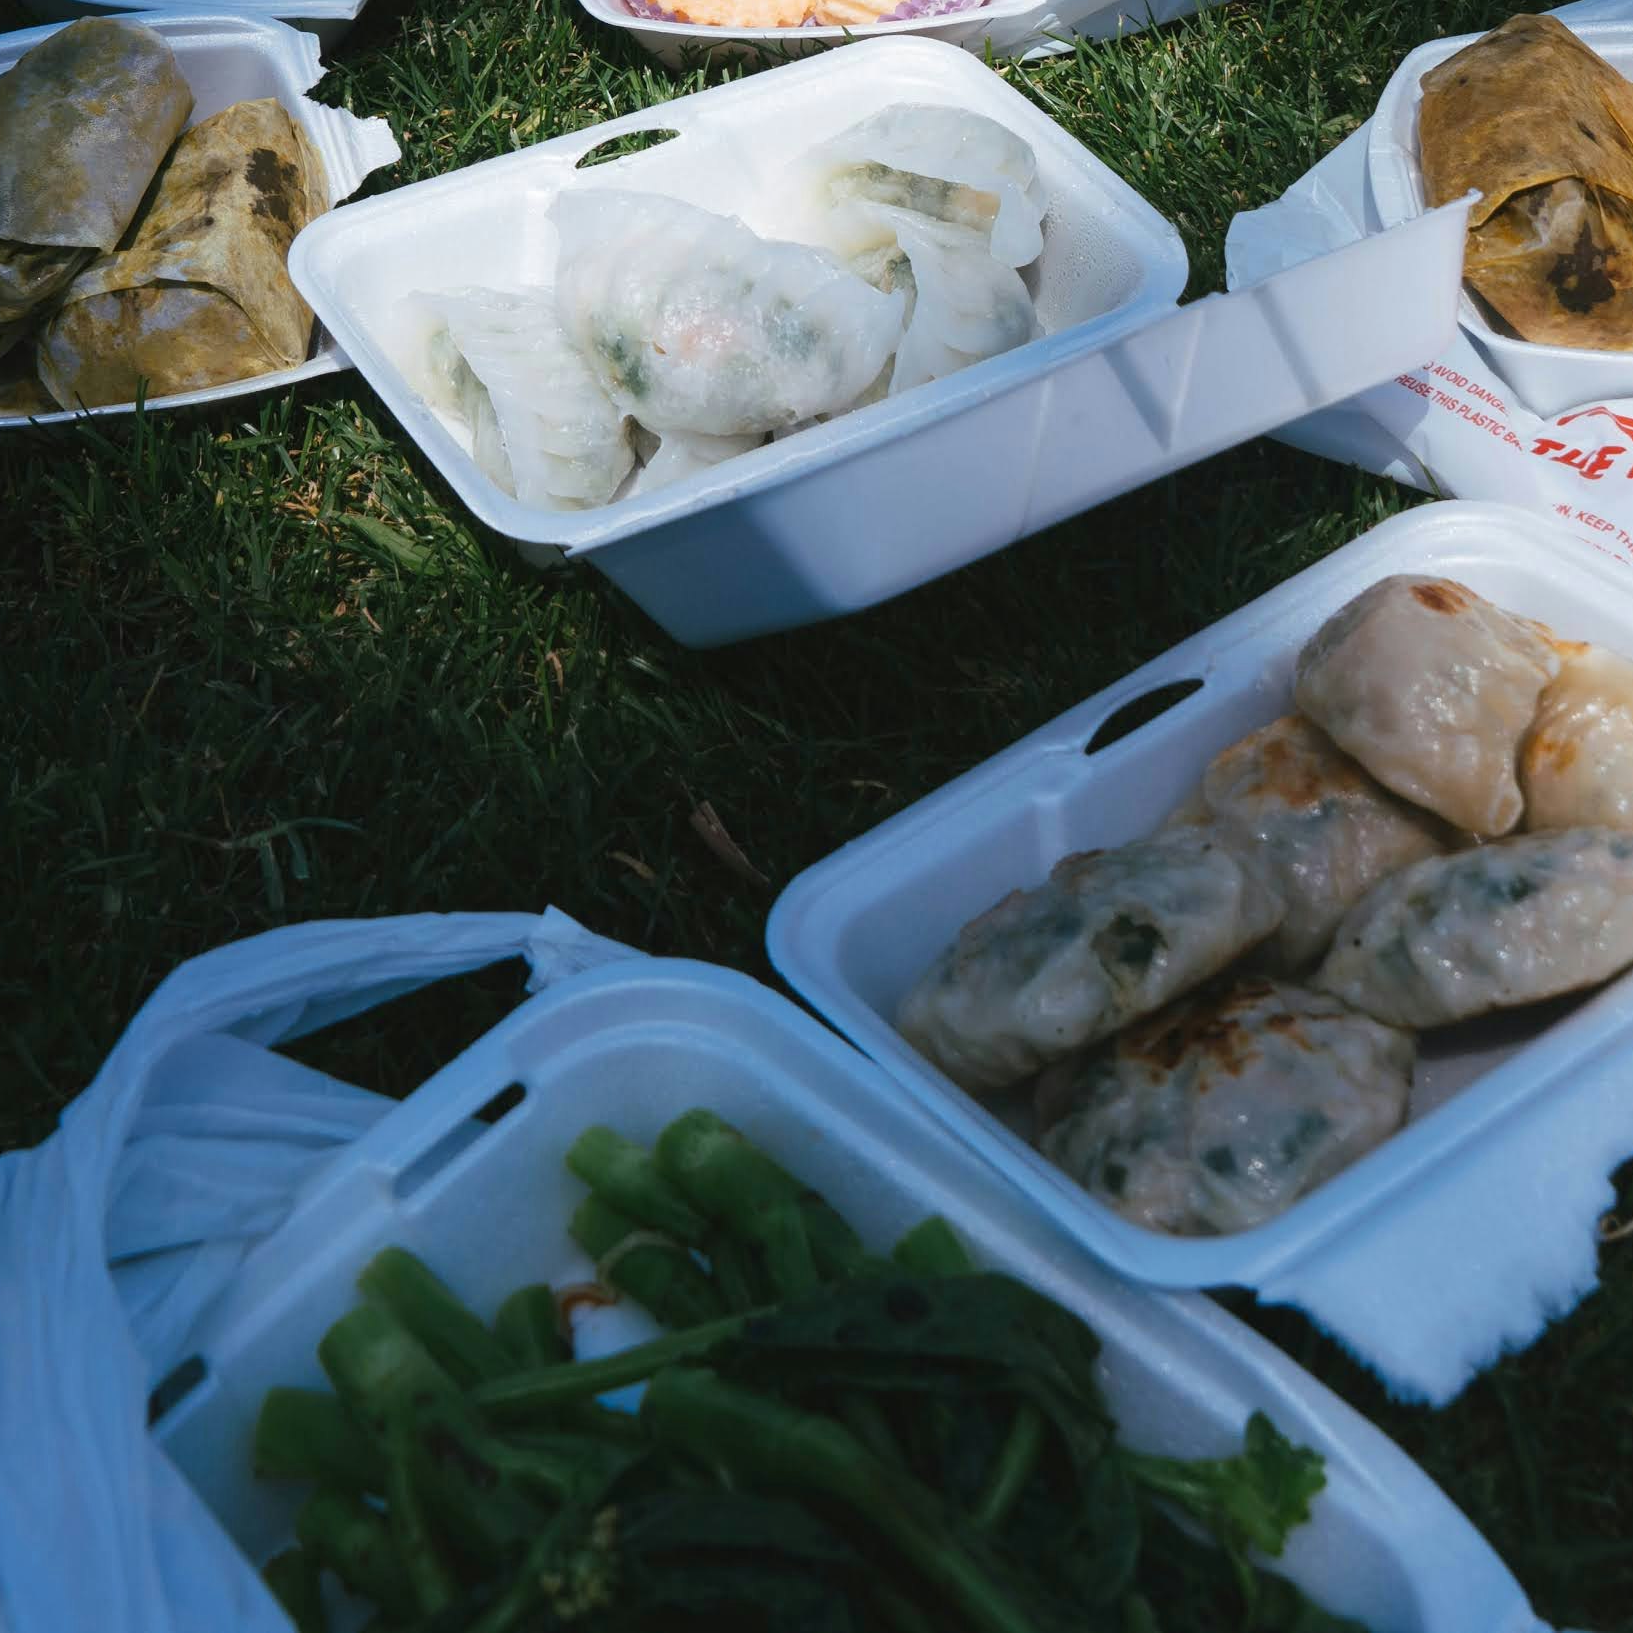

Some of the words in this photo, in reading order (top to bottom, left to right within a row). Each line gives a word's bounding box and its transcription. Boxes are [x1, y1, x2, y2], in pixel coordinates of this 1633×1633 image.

[1432, 365, 1469, 388] AVOID
[1394, 373, 1434, 398] REUSE
[1432, 390, 1460, 411] THIS
[1456, 404, 1506, 437] PLASTIC
[1575, 510, 1616, 532] KEEP
